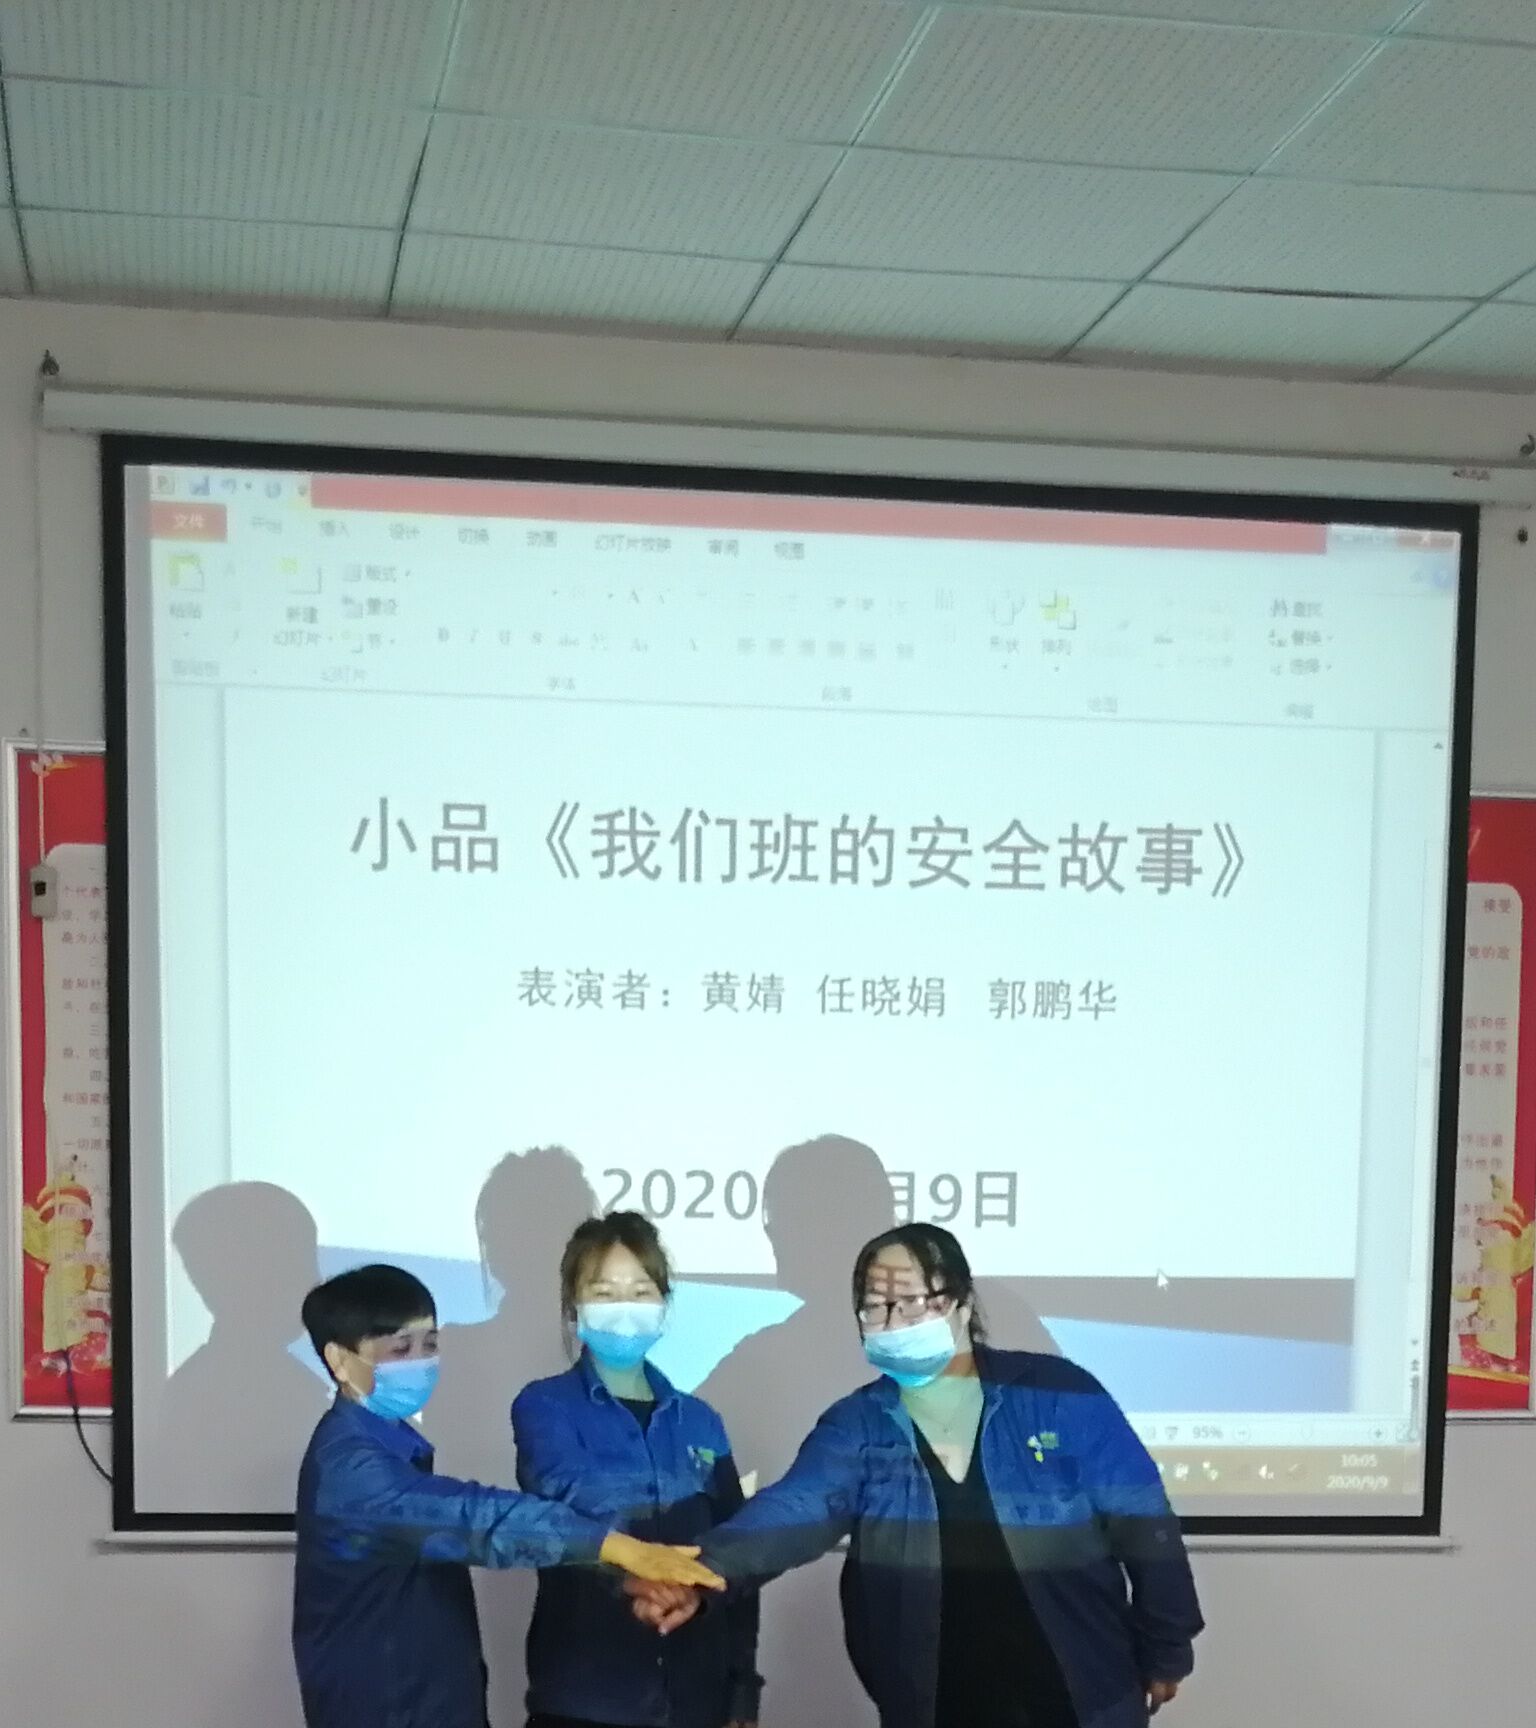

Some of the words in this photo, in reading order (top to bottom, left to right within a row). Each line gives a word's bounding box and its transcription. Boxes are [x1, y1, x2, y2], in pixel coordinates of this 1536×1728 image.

[816, 974, 947, 1019] 任晓娟
[987, 977, 1119, 1022] 郭鹏华
[1340, 1453, 1378, 1468] 10:05
